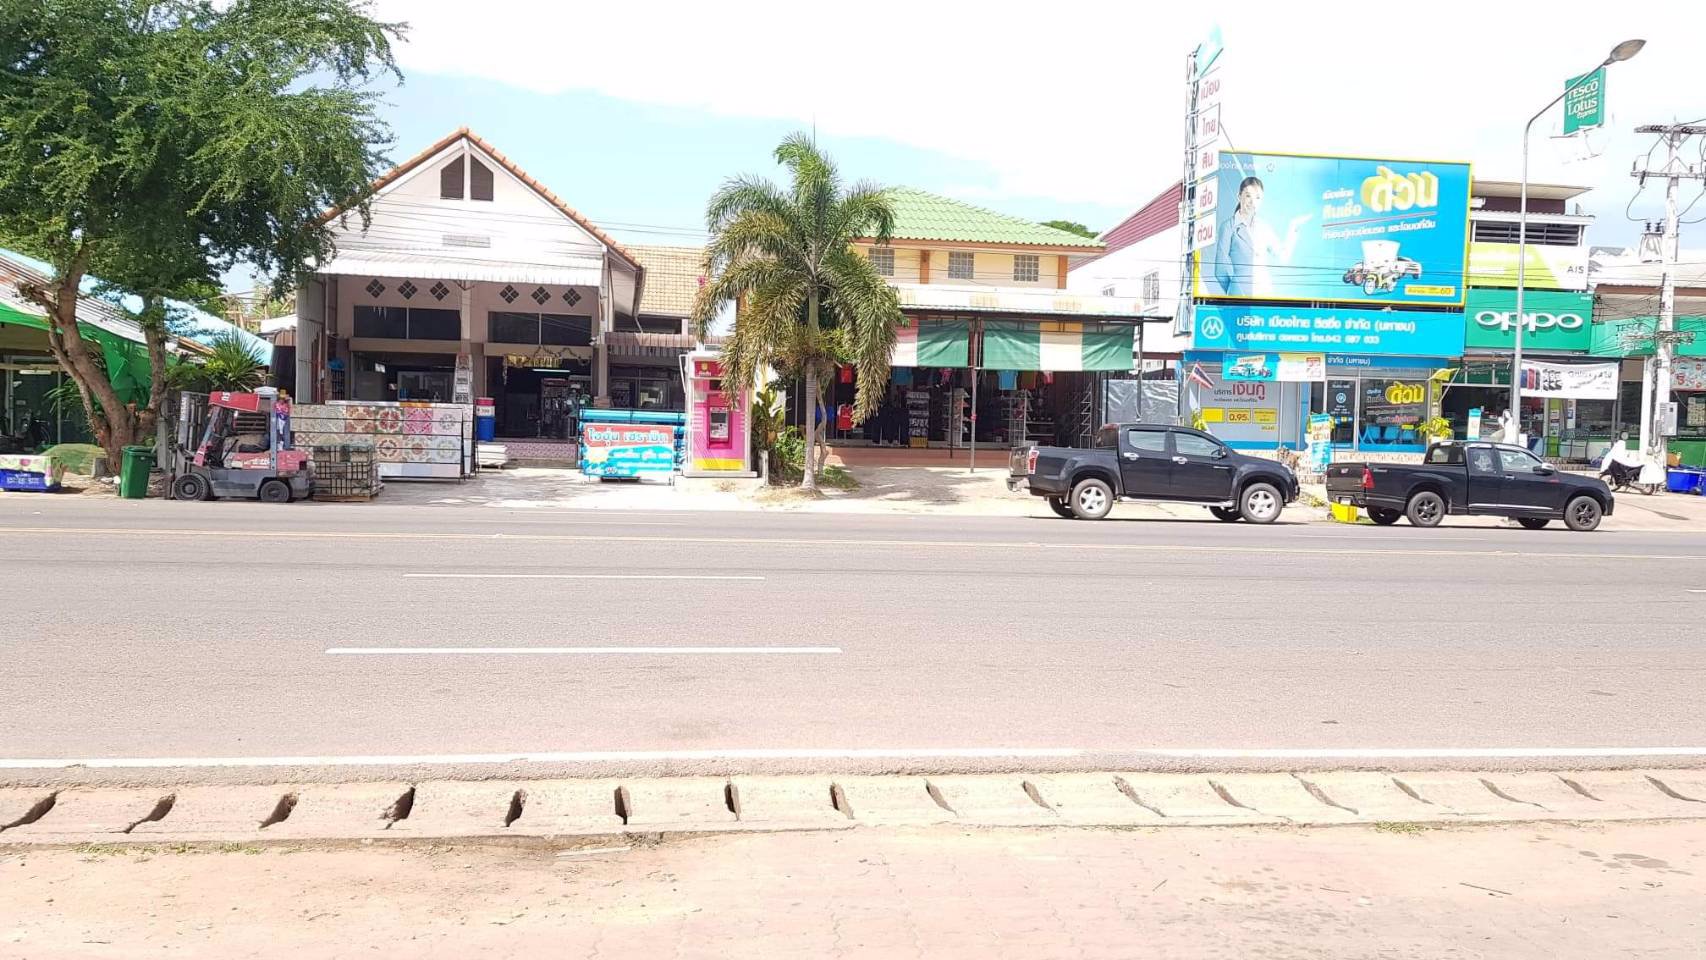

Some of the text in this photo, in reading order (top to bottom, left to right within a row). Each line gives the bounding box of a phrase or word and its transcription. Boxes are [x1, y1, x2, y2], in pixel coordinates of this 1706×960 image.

[1201, 79, 1220, 101] เมือง
[1568, 79, 1599, 99] TESCO
[1567, 97, 1598, 116] Lotus
[1203, 117, 1216, 137] ไทย
[1202, 152, 1214, 169] สิน
[1200, 184, 1213, 208] เชื่อ
[1361, 165, 1439, 213] ด่วน
[1197, 224, 1212, 242] ด่วน
[1566, 265, 1585, 275] AIS
[1236, 315, 1265, 327] บริษัท
[1268, 314, 1311, 328] เมืองไทย
[1344, 318, 1371, 330] จำกัด
[1374, 320, 1416, 334] (มหาชน)
[1345, 356, 1371, 366] (มหาชน)
[1385, 381, 1425, 405] ด่วน
